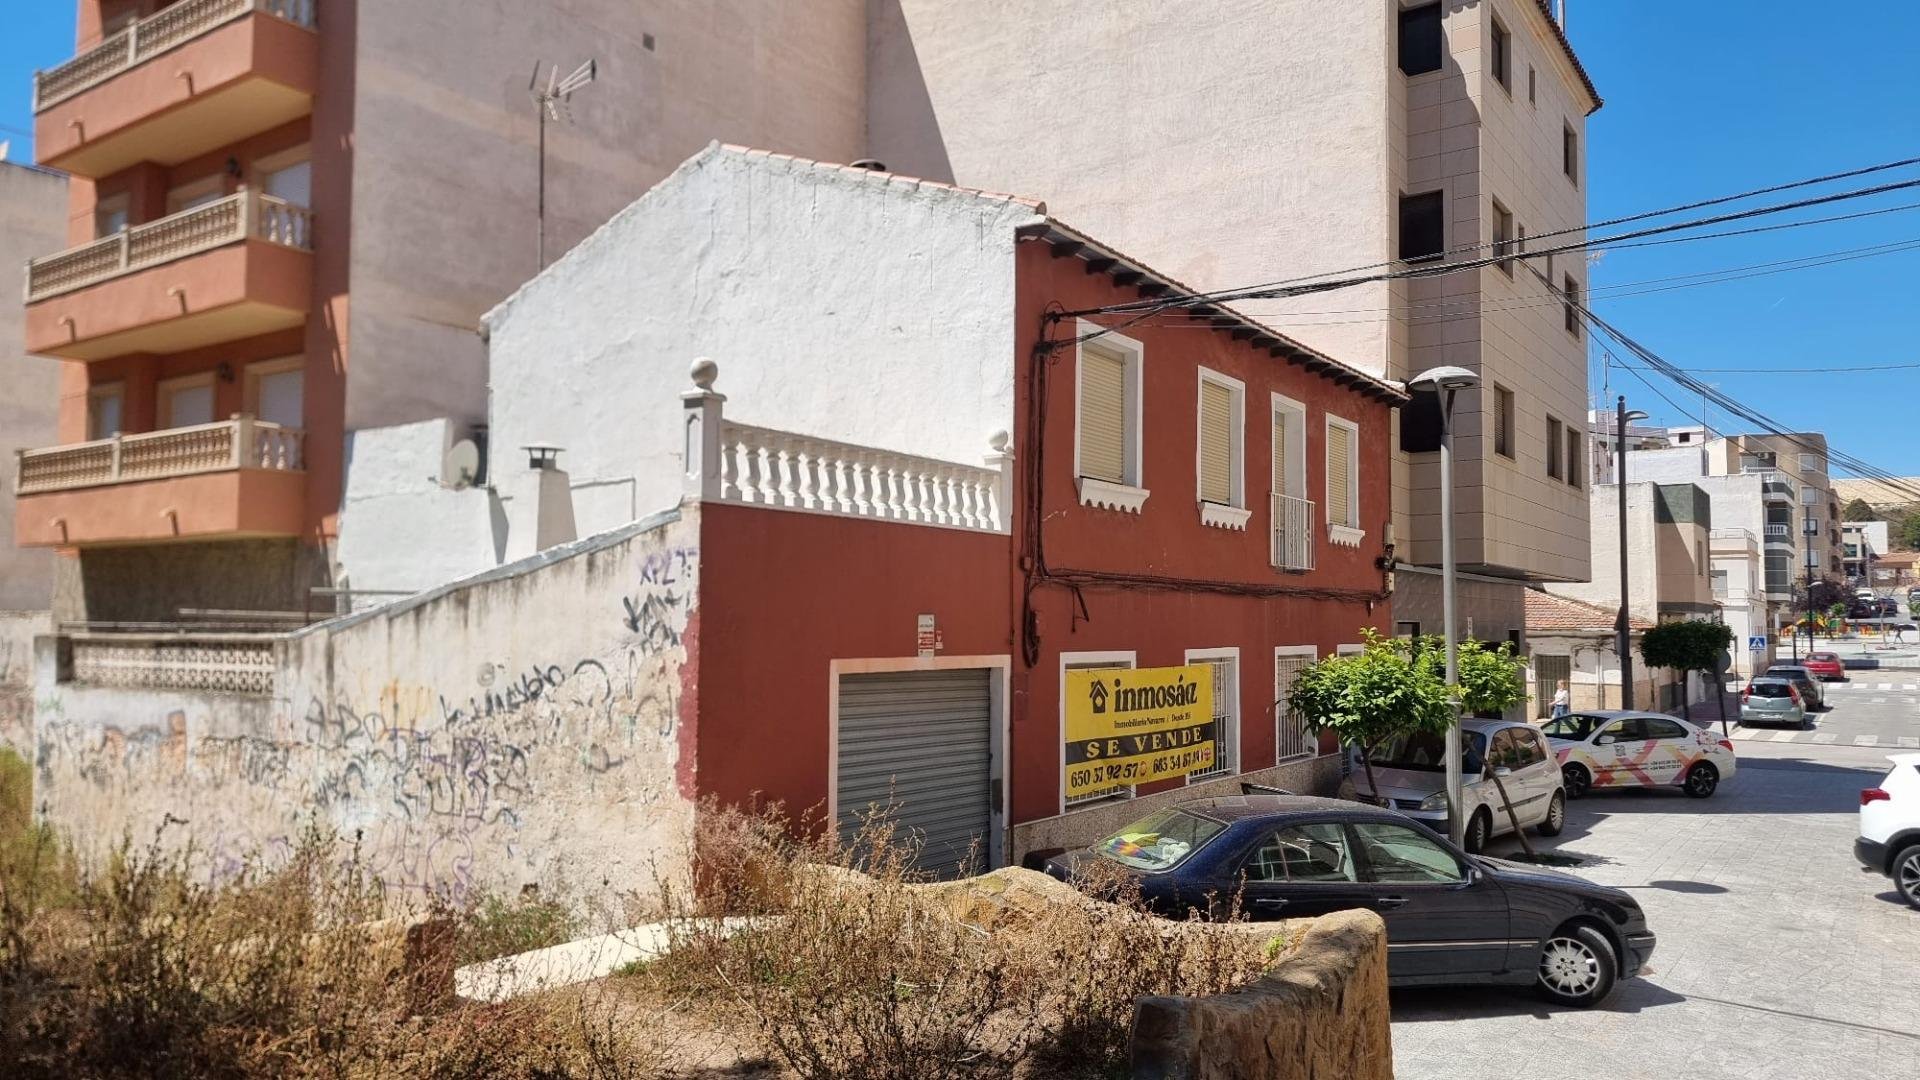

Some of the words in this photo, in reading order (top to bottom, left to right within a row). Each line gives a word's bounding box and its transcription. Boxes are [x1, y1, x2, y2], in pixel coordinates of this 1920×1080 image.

[1086, 739, 1120, 758] SE
[1134, 727, 1202, 752] VENDE
[1071, 769, 1091, 788] 650
[1093, 766, 1104, 784] 37
[1106, 764, 1121, 780] 92
[1123, 762, 1139, 778] 57
